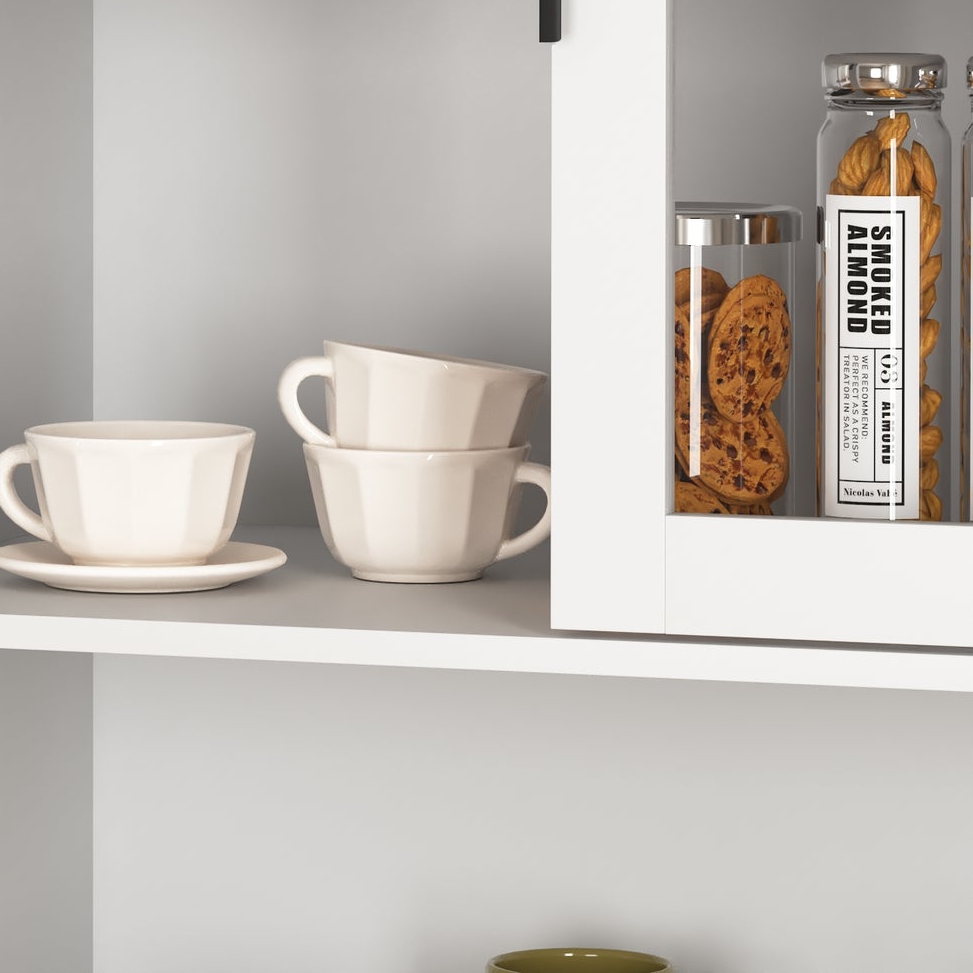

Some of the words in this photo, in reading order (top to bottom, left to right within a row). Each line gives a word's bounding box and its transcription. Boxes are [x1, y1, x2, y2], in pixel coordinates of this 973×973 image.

[847, 224, 868, 333] ALMOND
[861, 355, 869, 370] WE
[843, 402, 850, 413] IN
[852, 401, 859, 414] AS
[861, 373, 869, 440] RECOMMEND:
[843, 487, 874, 497] Nicolas
